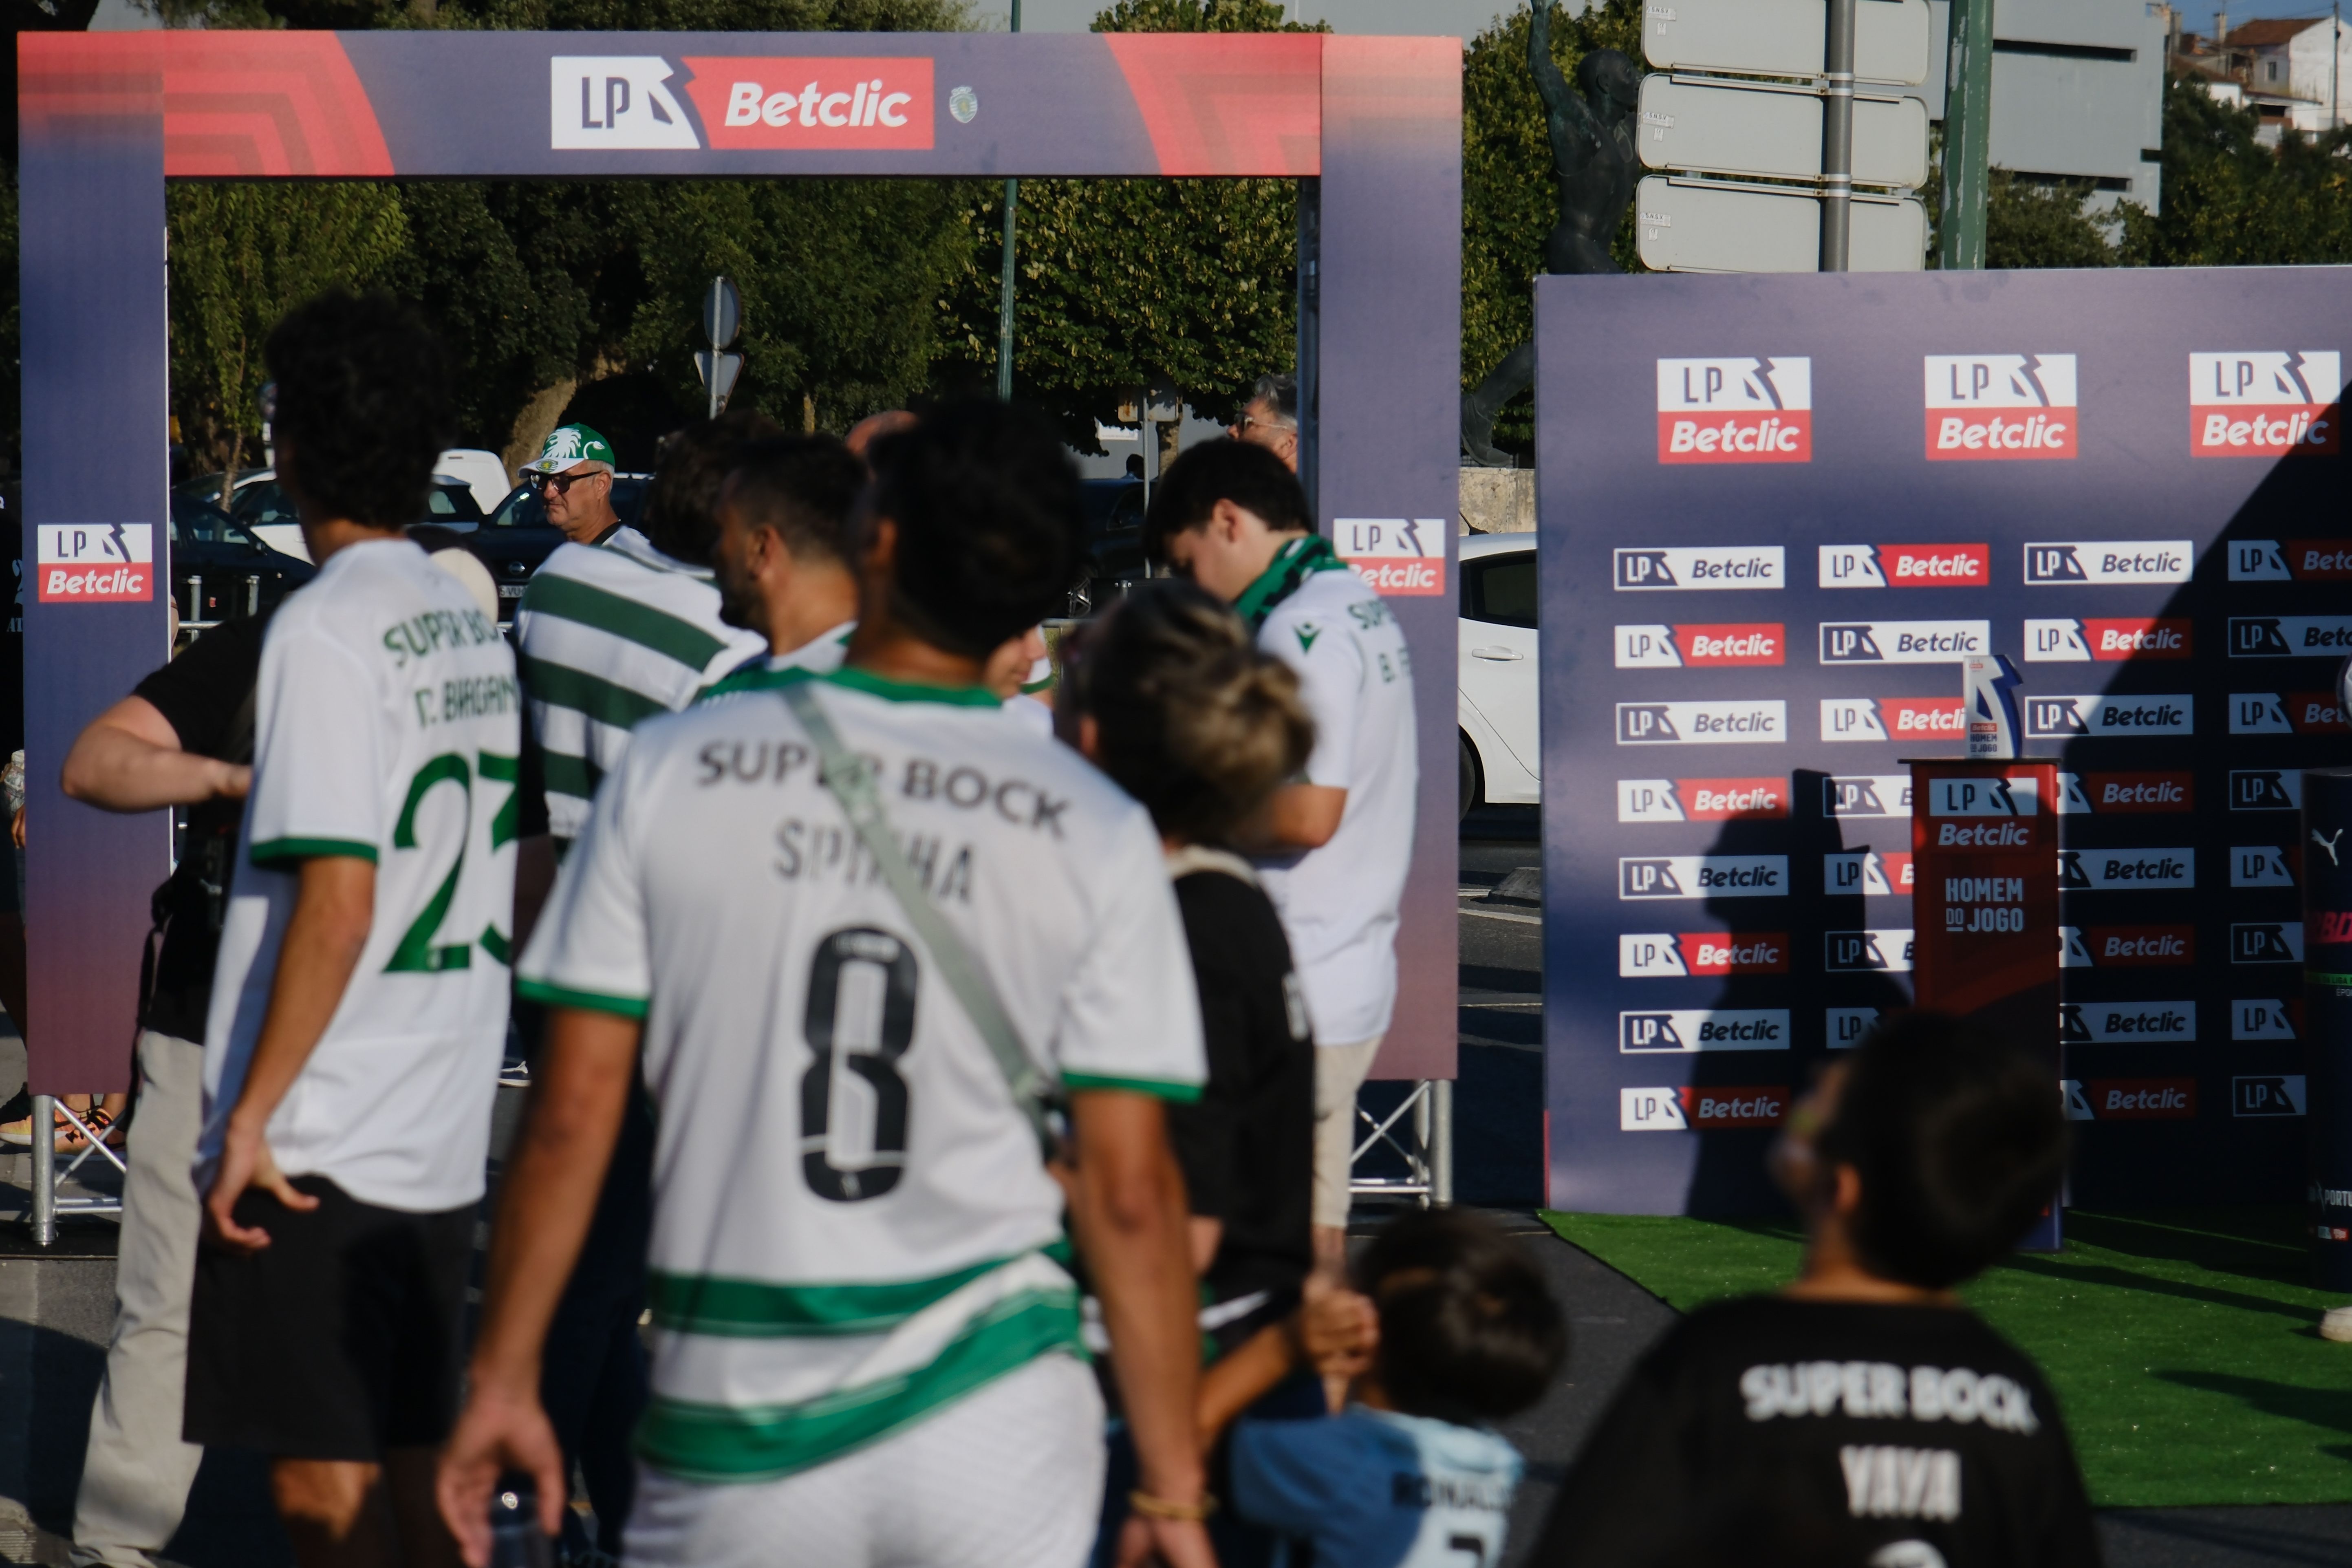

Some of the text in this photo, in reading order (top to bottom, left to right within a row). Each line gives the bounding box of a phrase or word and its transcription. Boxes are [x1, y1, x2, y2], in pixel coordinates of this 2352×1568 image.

[581, 77, 912, 129] LP Betclic
[1683, 366, 1722, 403] LP
[1950, 363, 1989, 399] LP
[2215, 360, 2254, 397] LP
[1669, 416, 1800, 454] Betclic
[1937, 413, 2065, 450] Betclic
[2202, 410, 2329, 448] Betclic
[57, 531, 86, 558] LP
[1353, 525, 1381, 551] LP
[1627, 557, 1773, 582] LP Betclic
[1833, 554, 1979, 578] LP Betclic
[2037, 551, 2182, 576] LP Betclic
[2240, 549, 2263, 572] LP
[46, 569, 143, 594] Betclic
[1629, 634, 1774, 658] LP Betclic
[1833, 631, 1978, 656] LP Betclic
[2038, 627, 2183, 651] LP Betclic
[2240, 625, 2263, 649] LP
[1629, 711, 1774, 736] LP Betclic
[1834, 708, 1856, 732] LP
[2037, 704, 2183, 730] LP Betclic
[2241, 701, 2264, 725] LP
[1970, 733, 1997, 742] HOMEM
[1977, 743, 1997, 752] JOGO
[904, 757, 1071, 840] BOCK
[1631, 788, 1778, 812] LP Betclic
[1947, 783, 1975, 811] LP
[2103, 781, 2184, 803] Betclic
[2242, 778, 2264, 802] LP
[1938, 821, 2029, 846] Betclic
[1836, 862, 1859, 886] LP
[2103, 858, 2185, 880] Betclic
[2242, 854, 2265, 878] LP
[1632, 866, 1778, 891] LP Betclic
[1945, 878, 2024, 902] HOMEM
[1946, 908, 2024, 932] DO JOGO
[1634, 943, 1779, 966] LP Betclic
[1838, 939, 1860, 963] LP
[2104, 935, 2185, 957] Betclic
[2243, 931, 2265, 955] LP
[1633, 1019, 1780, 1045] LP Betclic
[1838, 1016, 1861, 1041] LP
[2105, 1011, 2186, 1033] Betclic
[2244, 1008, 2266, 1032] LP
[800, 924, 920, 1204] 8
[1634, 1096, 1780, 1120] LP Betclic
[2106, 1087, 2187, 1109] Betclic
[2245, 1085, 2267, 1109] LP
[1740, 1360, 2039, 1436] SUPER BOCK
